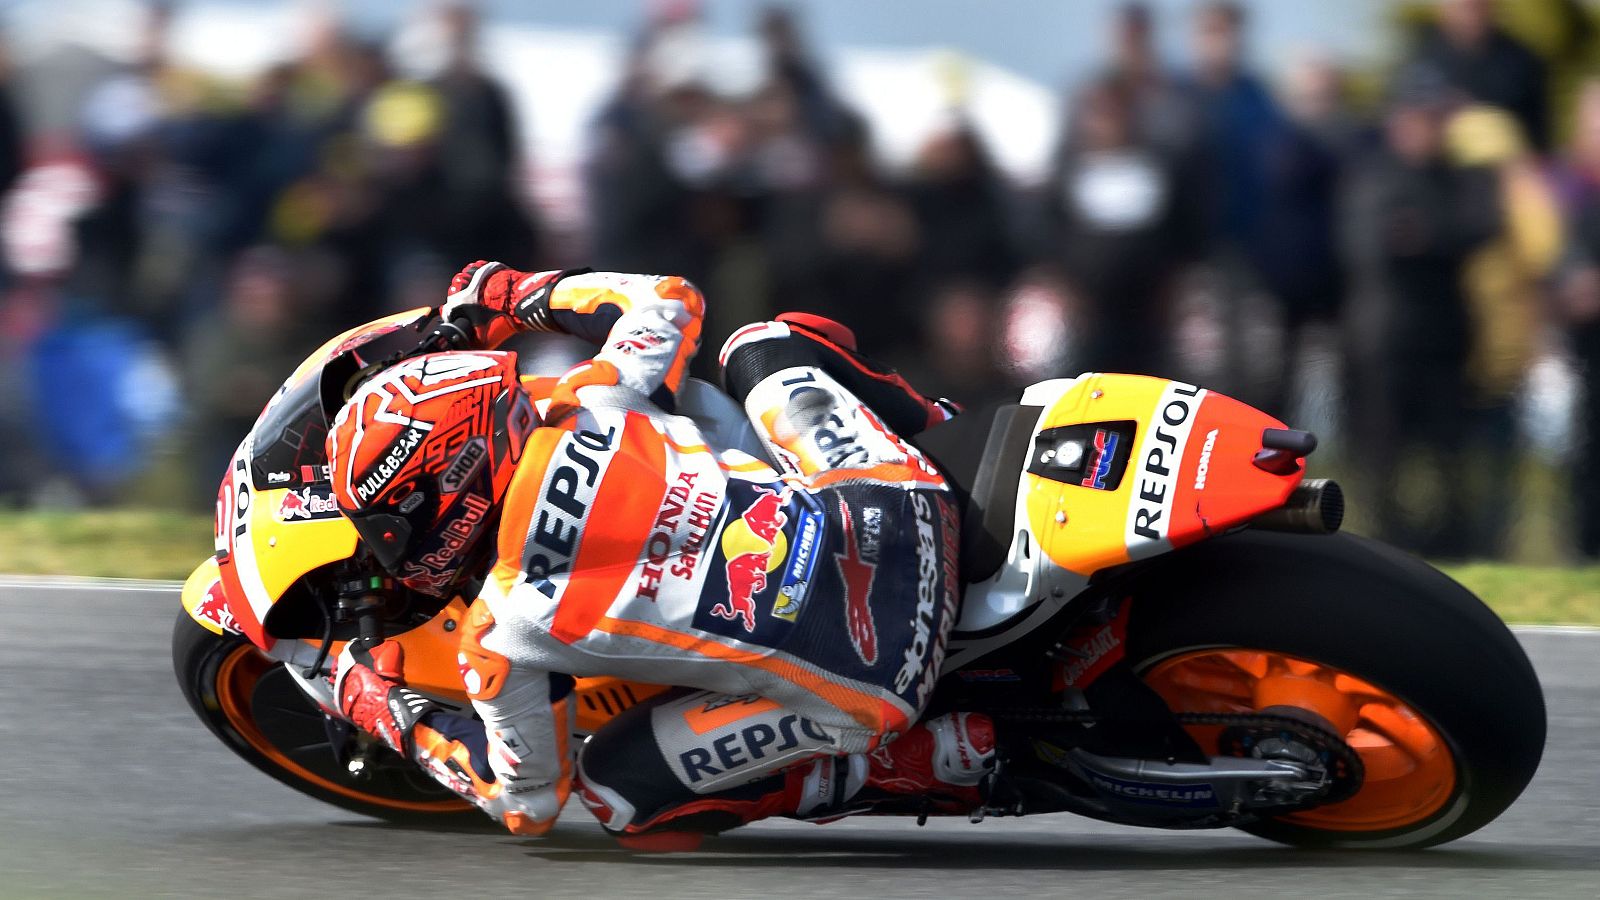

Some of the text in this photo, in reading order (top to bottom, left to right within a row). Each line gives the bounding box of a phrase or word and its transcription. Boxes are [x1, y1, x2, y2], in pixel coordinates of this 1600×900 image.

[356, 428, 424, 501] PULL&BEAR
[444, 441, 483, 489] SHOEI
[524, 426, 616, 600] REPSOL
[1134, 383, 1200, 540] REPSOL
[1194, 428, 1219, 490] HONDA
[636, 471, 699, 603] HONDA
[893, 491, 938, 695] alpinestars
